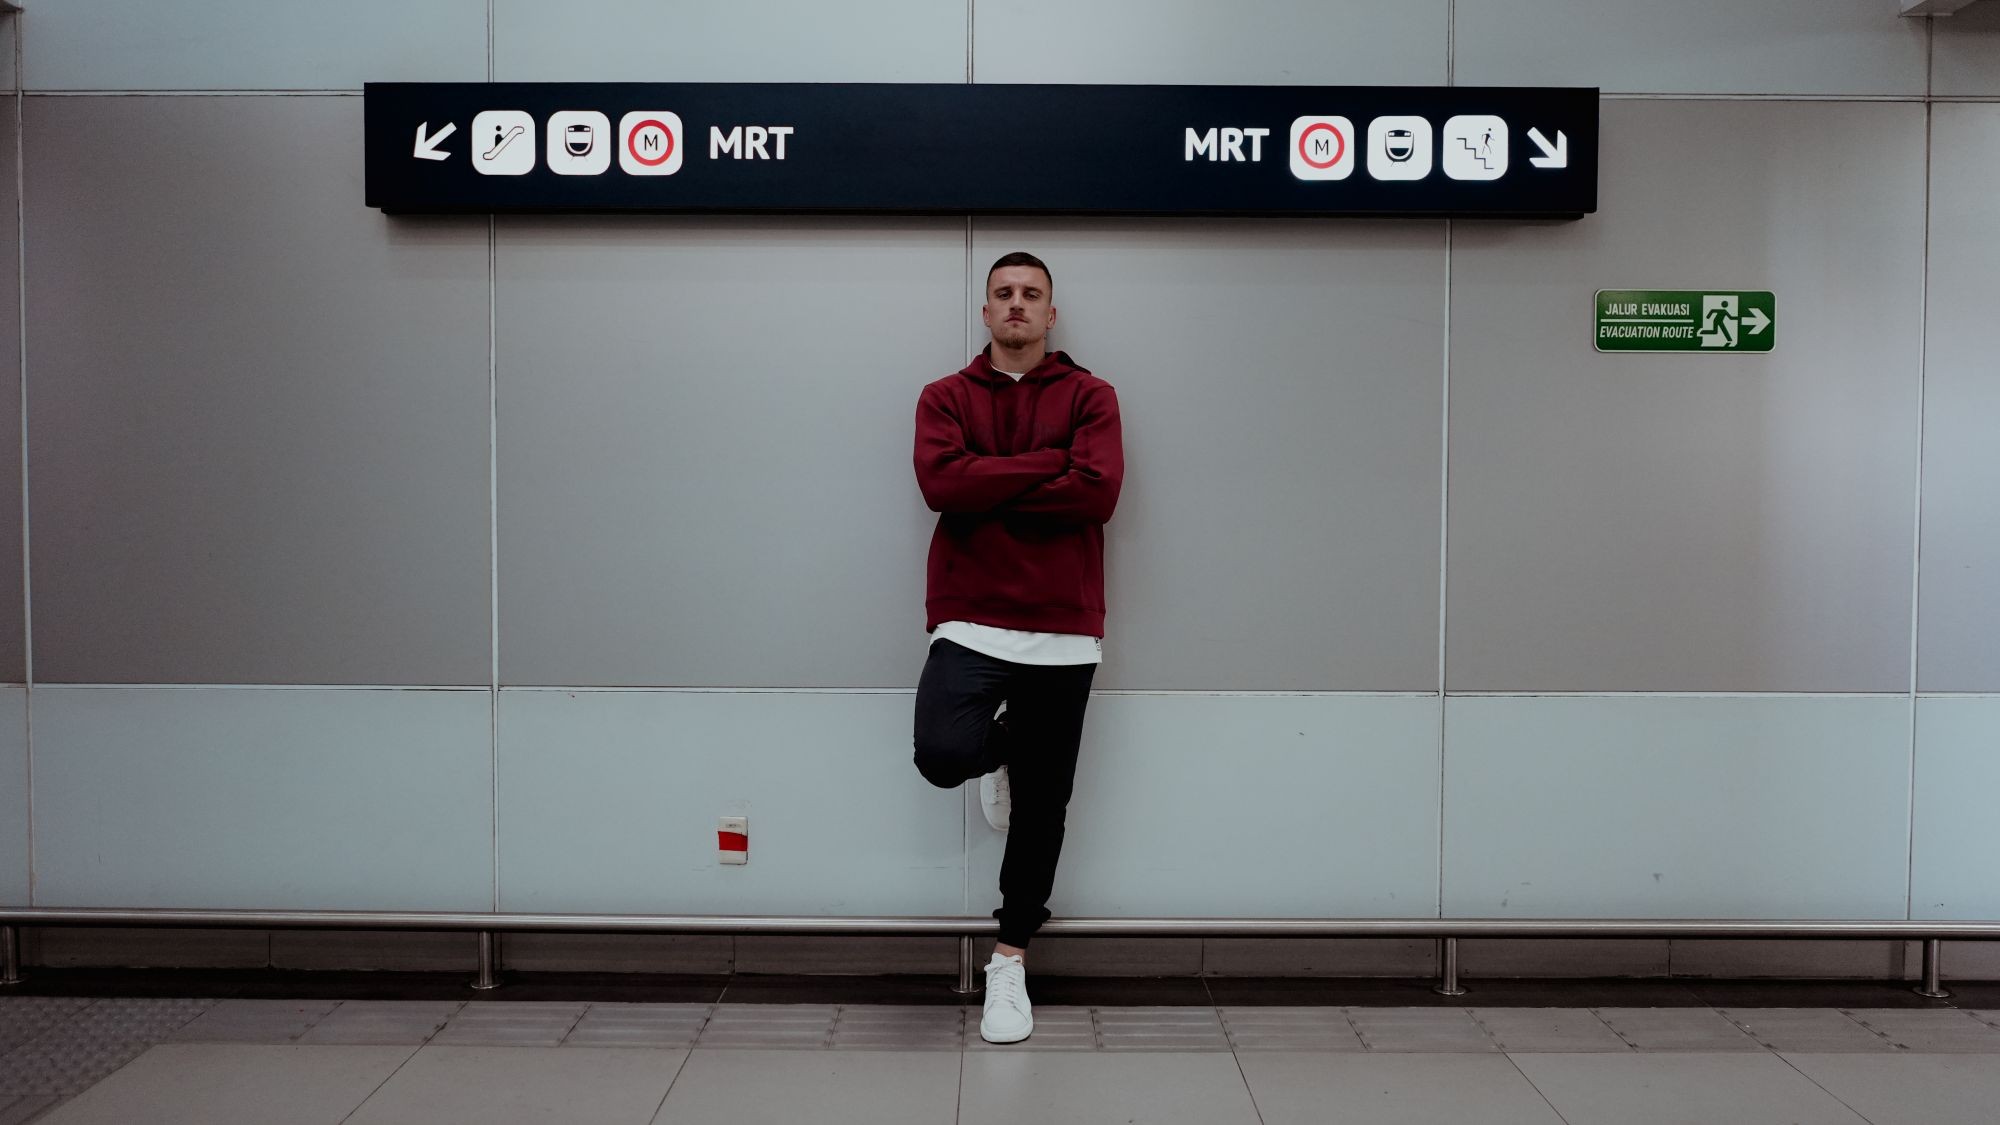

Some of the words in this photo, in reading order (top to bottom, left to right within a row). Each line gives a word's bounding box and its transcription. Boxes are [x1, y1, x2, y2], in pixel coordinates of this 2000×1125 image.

[644, 134, 659, 152] M
[709, 125, 794, 160] MRT
[1184, 127, 1270, 162] MRT
[1315, 139, 1329, 156] M
[1604, 303, 1638, 316] JALUR
[1641, 303, 1690, 316] EVAKUASI
[1599, 325, 1661, 339] EVACUATION
[1662, 325, 1695, 339] ROUTE
